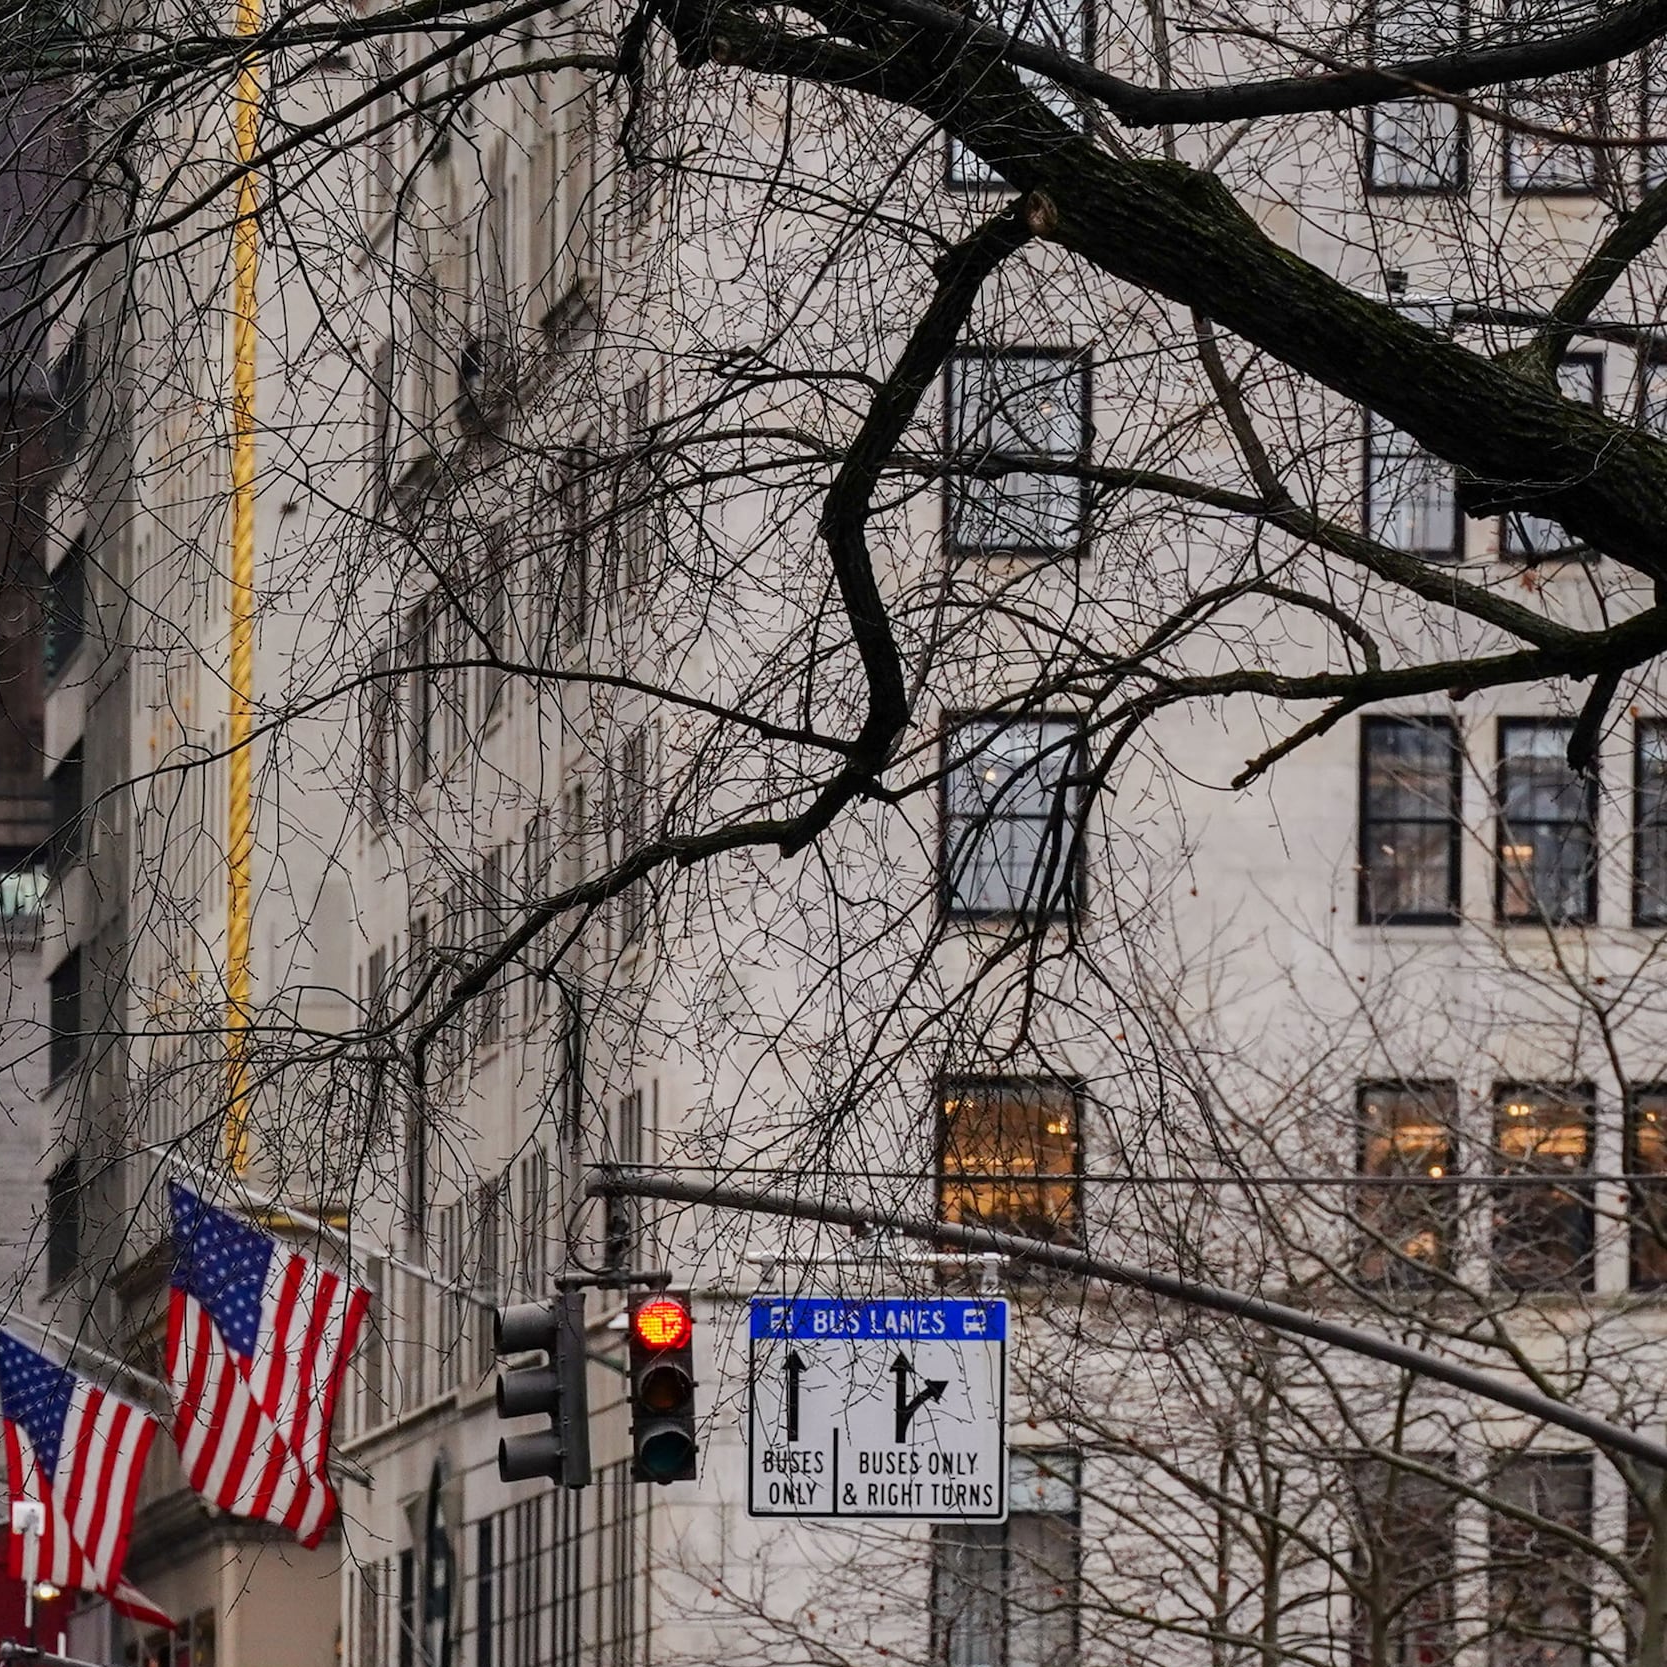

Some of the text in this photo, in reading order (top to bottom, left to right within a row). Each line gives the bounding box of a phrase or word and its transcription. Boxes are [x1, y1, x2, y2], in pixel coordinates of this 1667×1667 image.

[813, 1310, 946, 1335] BUS LANES
[859, 1451, 978, 1475] BUSES ONLY
[764, 1450, 824, 1505] BUSES ONLY
[843, 1483, 993, 1507] & RIGHT TURNS
